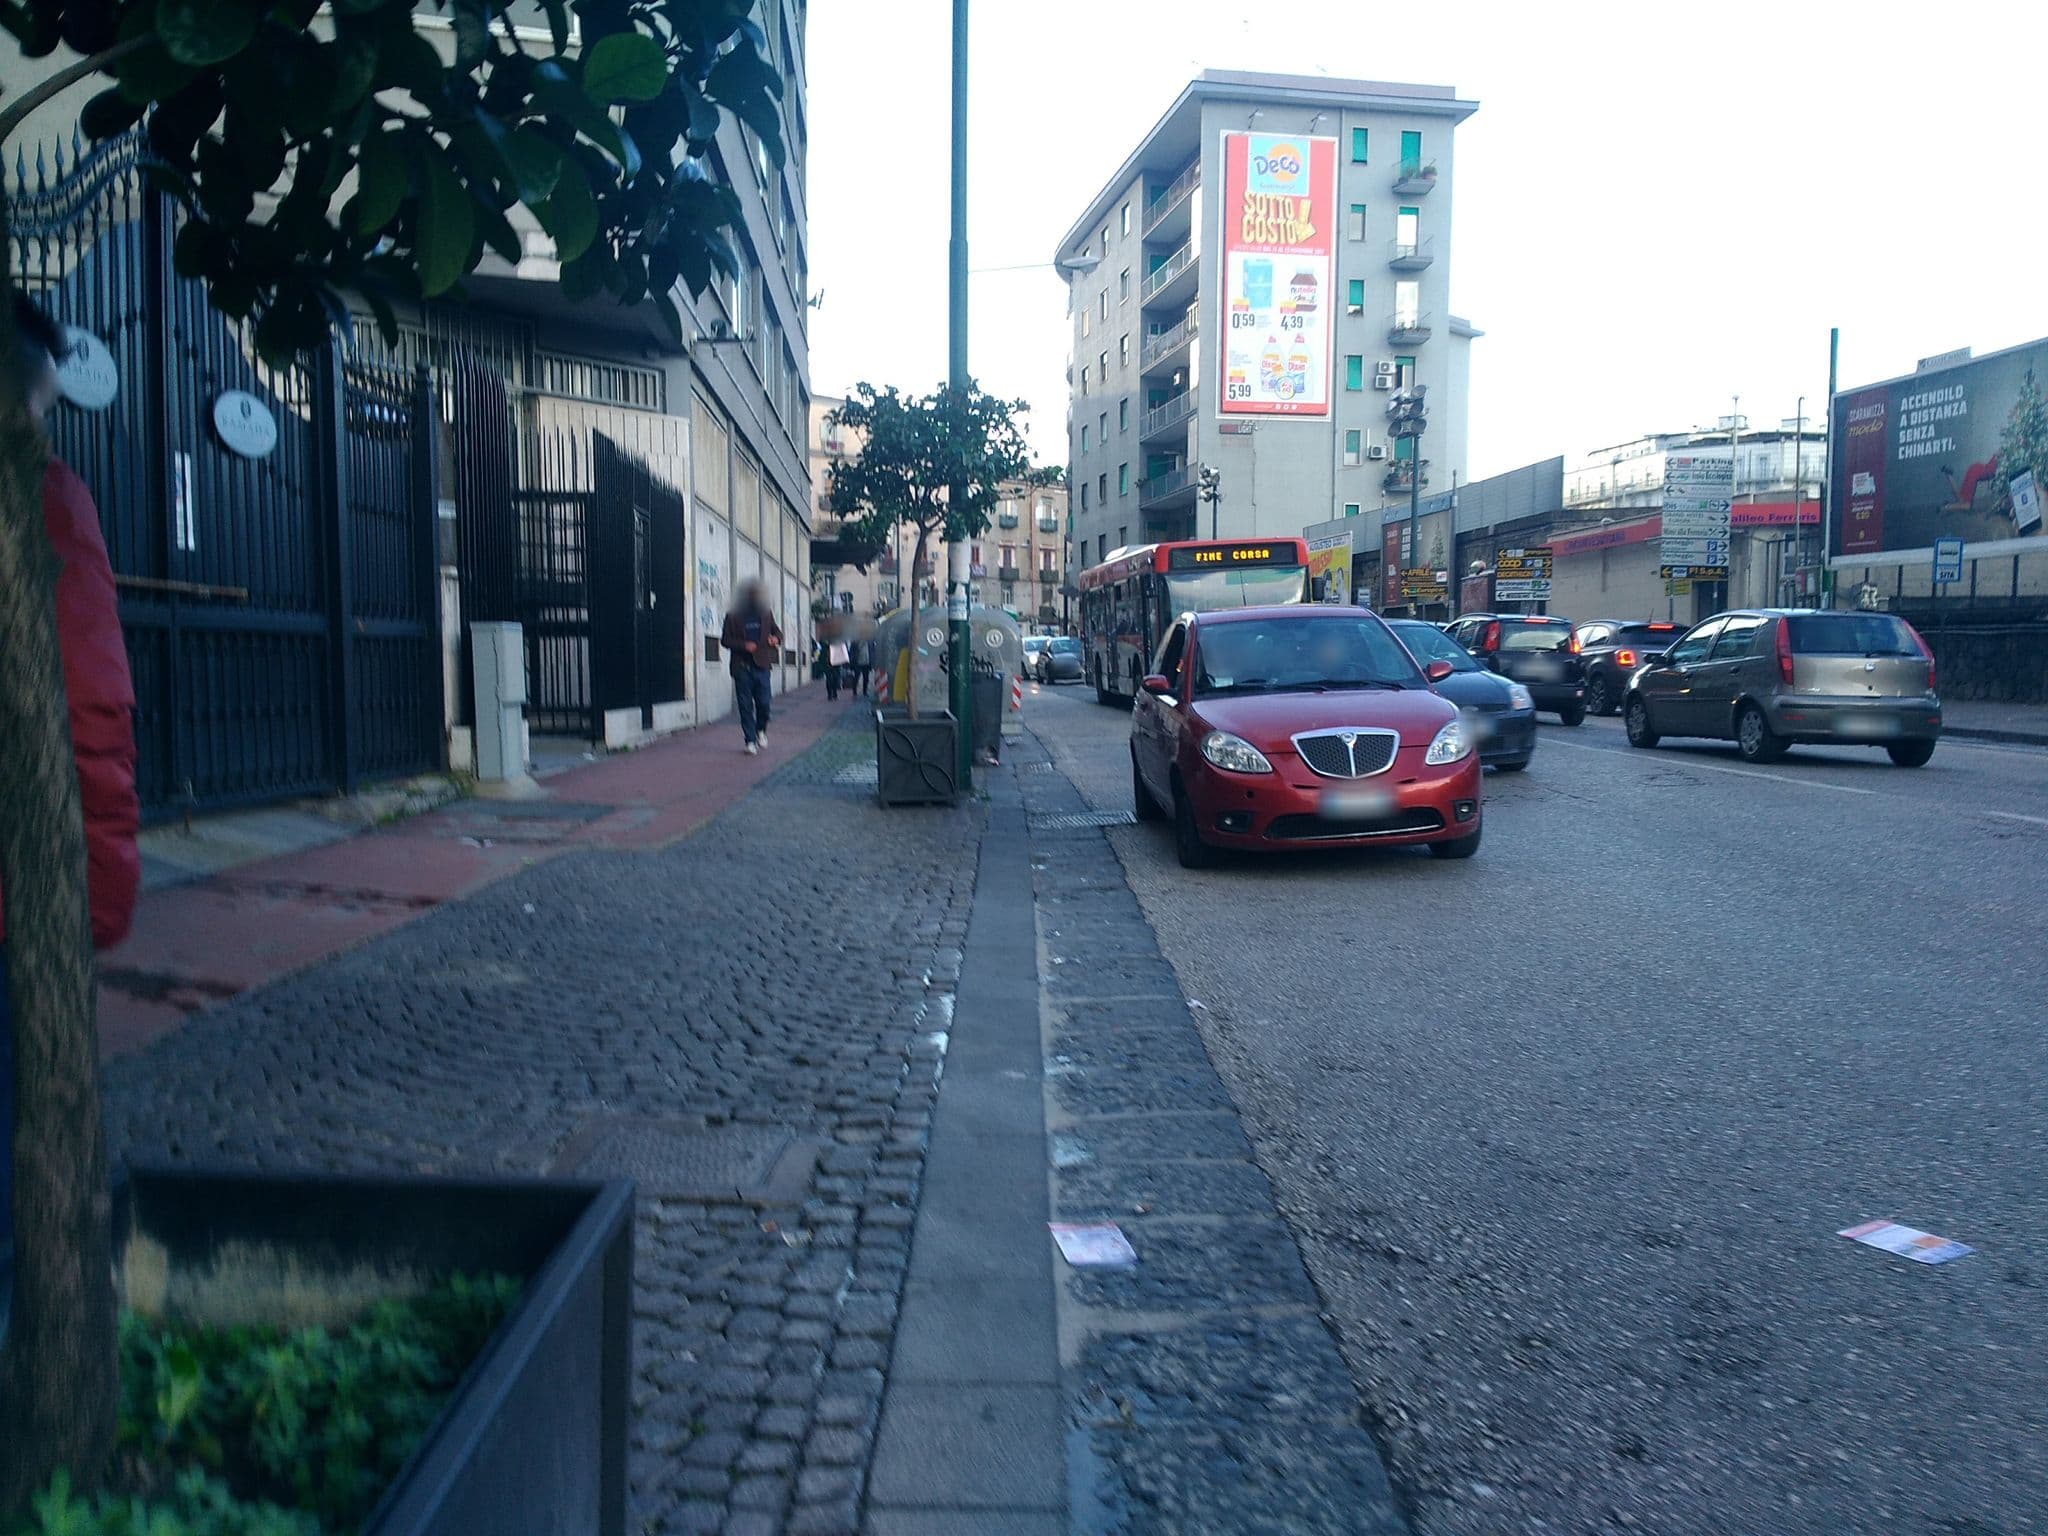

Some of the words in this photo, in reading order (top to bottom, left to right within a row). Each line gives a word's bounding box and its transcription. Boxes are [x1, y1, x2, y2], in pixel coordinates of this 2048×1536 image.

[1244, 191, 1296, 220] SOTTO
[1242, 214, 1297, 244] COSTO
[1900, 384, 1964, 412] ACCENDILO
[1900, 412, 1908, 428] A
[1911, 400, 1968, 425] DISTANZA
[1899, 425, 1935, 444] SENZA
[1898, 437, 1956, 460] CHINARTI.
[1692, 457, 1733, 466] Parking
[1731, 513, 1765, 523] alileo
[1768, 512, 1817, 522] Ferraris
[1232, 549, 1270, 560] CORSA
